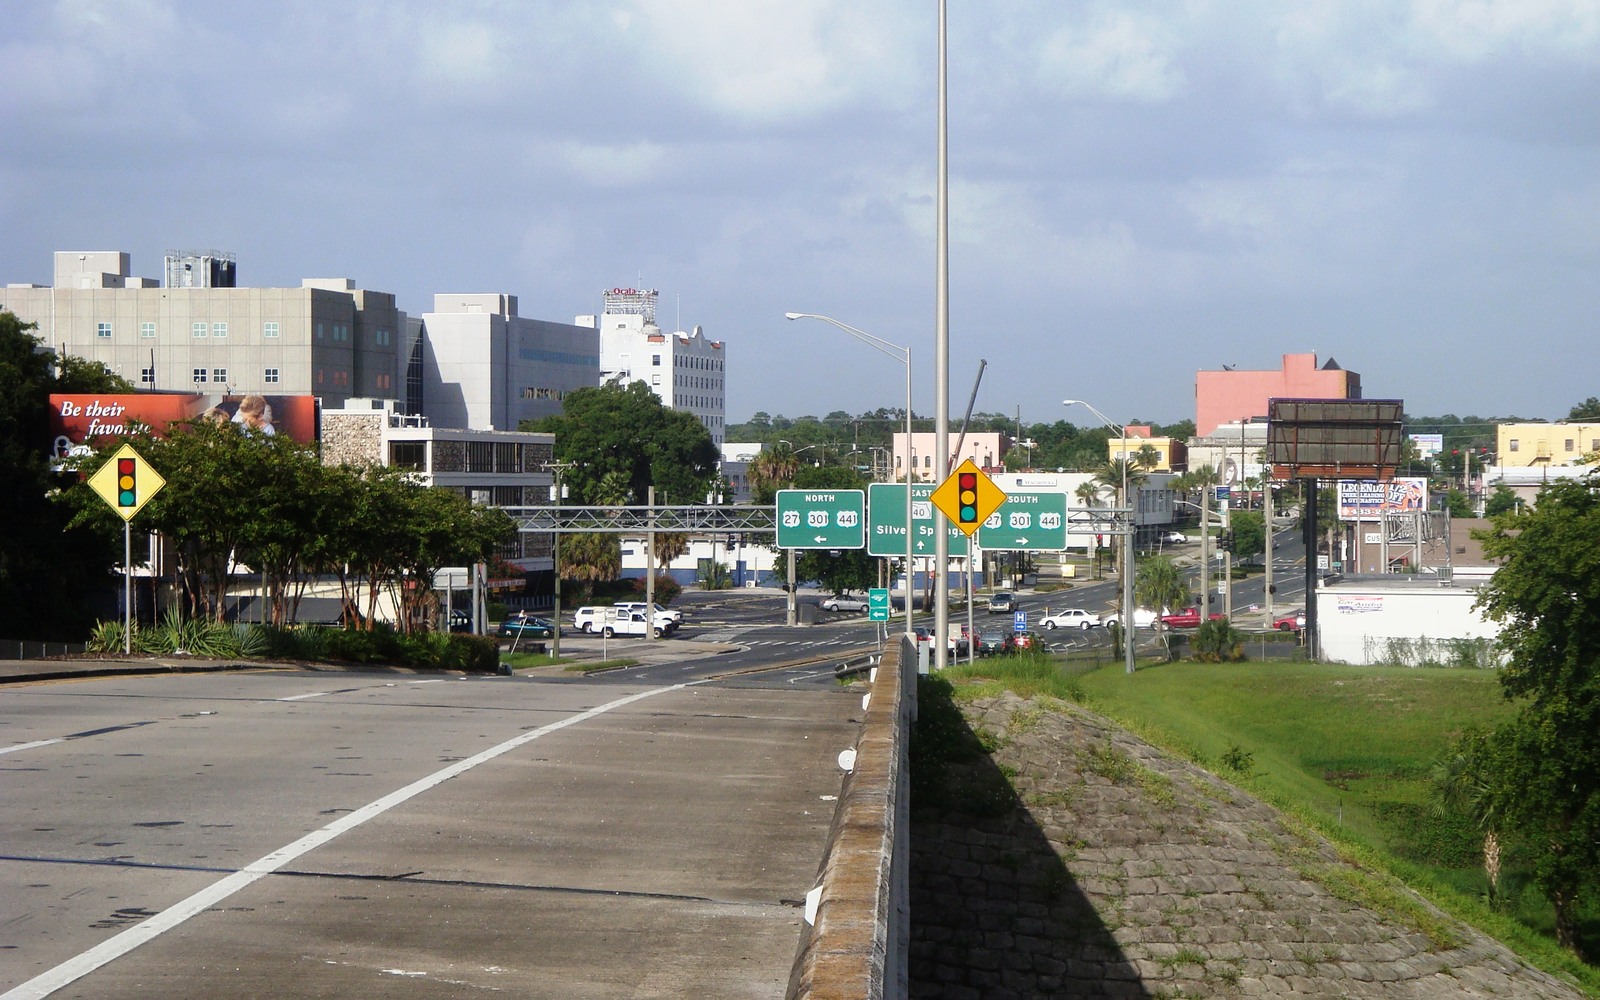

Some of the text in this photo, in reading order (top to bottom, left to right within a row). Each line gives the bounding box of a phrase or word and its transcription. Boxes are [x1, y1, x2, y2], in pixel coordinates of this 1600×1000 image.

[613, 288, 636, 296] Ocala
[60, 400, 126, 417] Be their
[911, 489, 932, 497] EAST
[805, 494, 835, 502] NORTH
[1008, 495, 1038, 503] SOUTH
[913, 508, 925, 517] 40
[784, 514, 856, 524] 27 301 441
[986, 515, 1059, 527] 27 301 441
[876, 525, 964, 538] Silve Spgs
[1017, 613, 1025, 622] H
